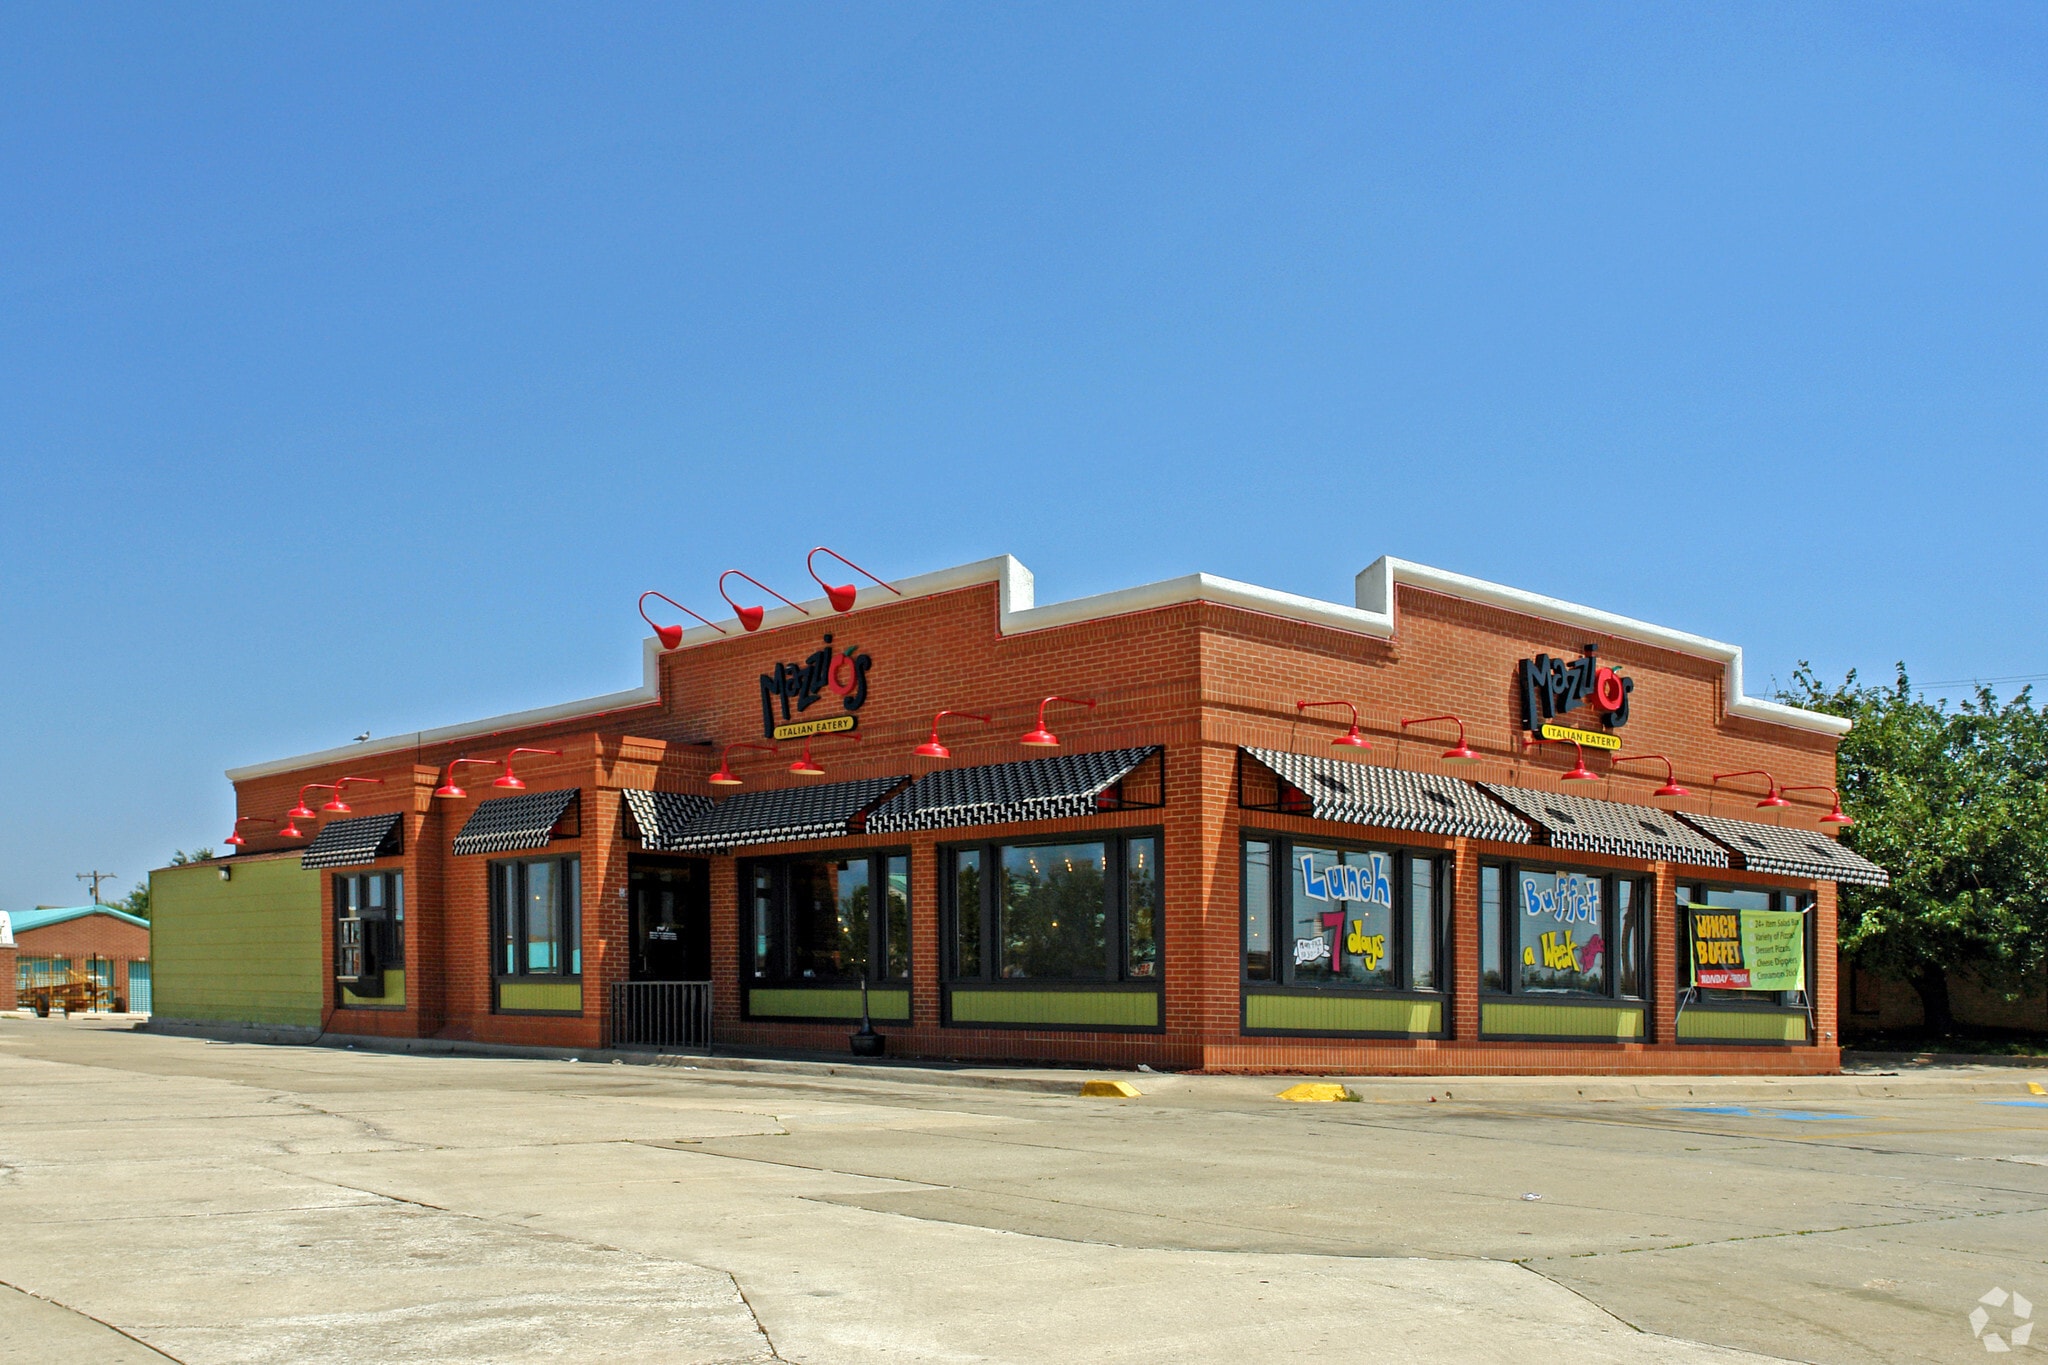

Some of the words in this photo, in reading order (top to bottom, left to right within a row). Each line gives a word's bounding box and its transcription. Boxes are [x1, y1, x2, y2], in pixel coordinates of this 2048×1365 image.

[779, 725, 813, 737] ITALIAN
[816, 719, 849, 732] EATERY
[1547, 727, 1582, 742] ITALIAN
[1585, 735, 1617, 748] EATERY
[1300, 853, 1392, 909] Lunch
[1523, 877, 1599, 925] Buffet
[1695, 914, 1737, 939] LUNCH
[1321, 911, 1346, 972] 7
[1347, 919, 1385, 971] days
[1755, 933, 1772, 943] Variety
[1773, 932, 1780, 940] of
[1523, 946, 1537, 966] a
[1541, 930, 1581, 972] Week
[1696, 941, 1741, 965] BUFFET
[1755, 946, 1774, 954] Dessert
[1774, 957, 1798, 967] Dippers
[1701, 974, 1728, 984] MONDAY
[1757, 971, 1785, 980] Cinnamon
